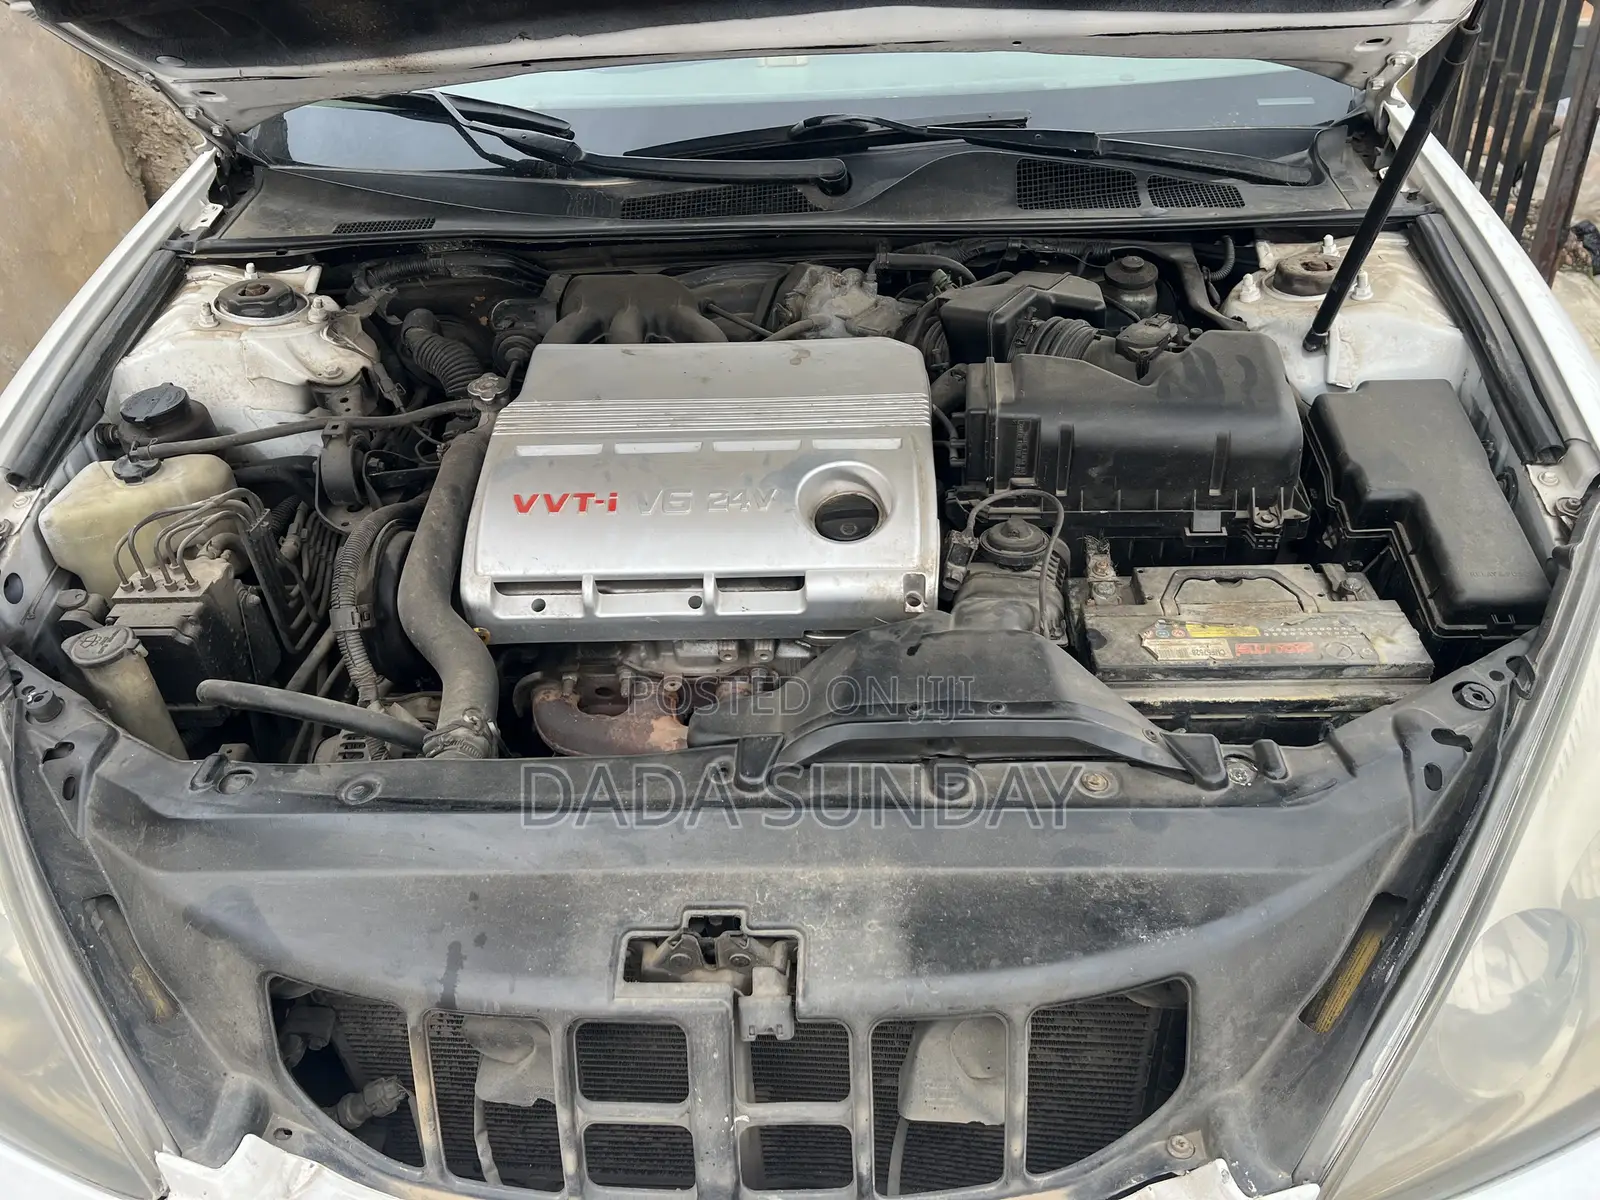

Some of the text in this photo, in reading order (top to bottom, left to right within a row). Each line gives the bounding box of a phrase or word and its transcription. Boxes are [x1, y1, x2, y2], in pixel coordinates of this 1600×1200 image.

[513, 488, 778, 516] VVT-i V6 24V
